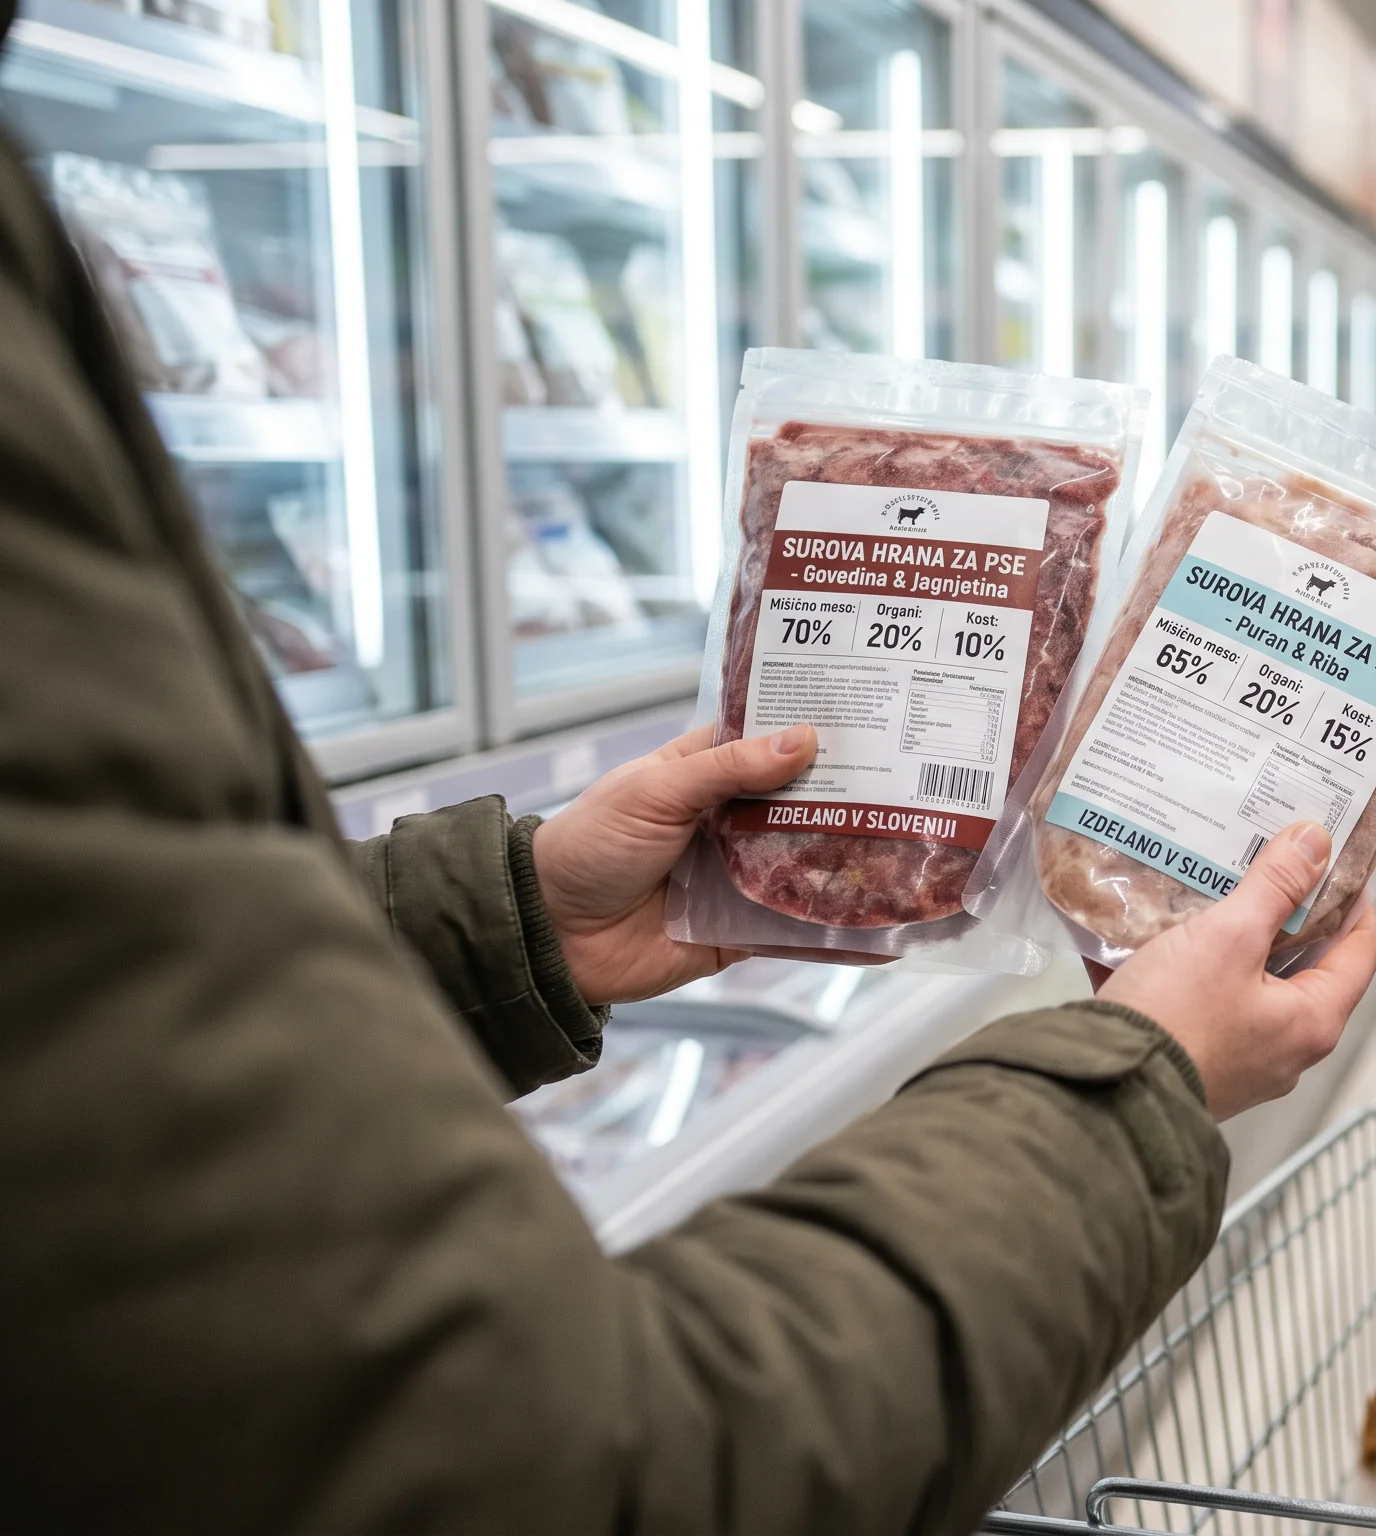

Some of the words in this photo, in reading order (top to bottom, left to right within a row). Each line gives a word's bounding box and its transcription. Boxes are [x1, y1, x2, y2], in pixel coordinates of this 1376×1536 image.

[782, 537, 865, 562] SUROVA
[871, 542, 945, 568] HRANA
[950, 548, 978, 571] ZA
[984, 552, 1027, 576] PSE
[803, 565, 888, 588] Govedina
[893, 572, 906, 589] &
[910, 573, 1009, 599] Jagnjetina
[819, 602, 856, 614] meso:
[876, 603, 923, 619] Organi:
[966, 611, 999, 627] Kost:
[1185, 565, 1268, 615] SUROVA
[1269, 600, 1343, 650] HRANA
[1343, 635, 1374, 665] ZA
[781, 618, 833, 646] 70%
[866, 622, 923, 651] 20%
[954, 630, 1006, 661] 10%
[1155, 643, 1215, 686] 65%
[1203, 640, 1241, 665] meso:
[1235, 615, 1289, 653] Puran
[1291, 641, 1307, 662] &
[1308, 649, 1351, 683] Riba
[1258, 663, 1304, 694] Organi:
[1239, 681, 1301, 727] 20%
[1341, 702, 1374, 728] Kost:
[1320, 717, 1374, 762] 15%
[766, 806, 847, 828] IZDELANO
[851, 810, 865, 828] V
[866, 810, 957, 839] SLOVENIJI
[1077, 808, 1163, 860] IZDELANO
[1163, 847, 1180, 867] V
[1177, 856, 1239, 897] SLOVE
